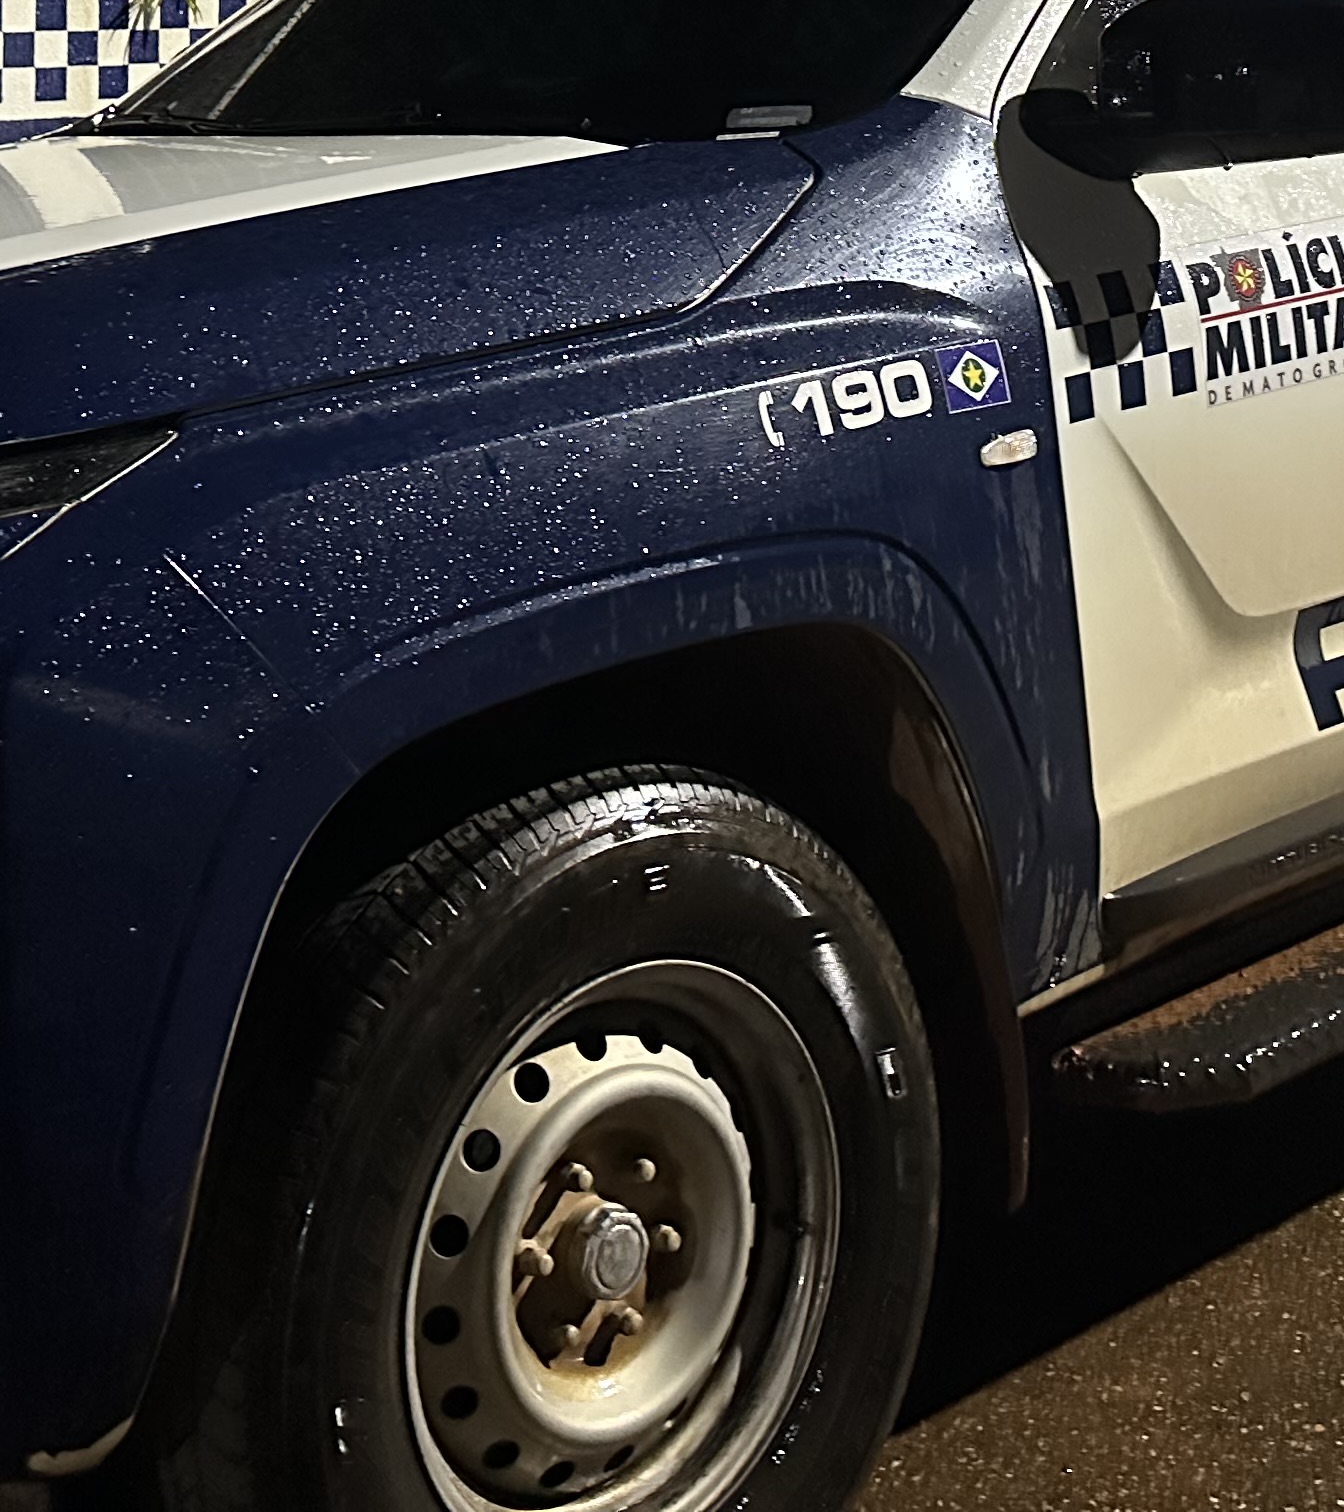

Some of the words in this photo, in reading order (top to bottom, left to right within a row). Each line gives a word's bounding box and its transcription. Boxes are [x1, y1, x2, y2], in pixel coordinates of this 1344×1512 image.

[790, 359, 934, 437] 190
[1208, 385, 1233, 406] DE
[1242, 367, 1304, 398] MATO
